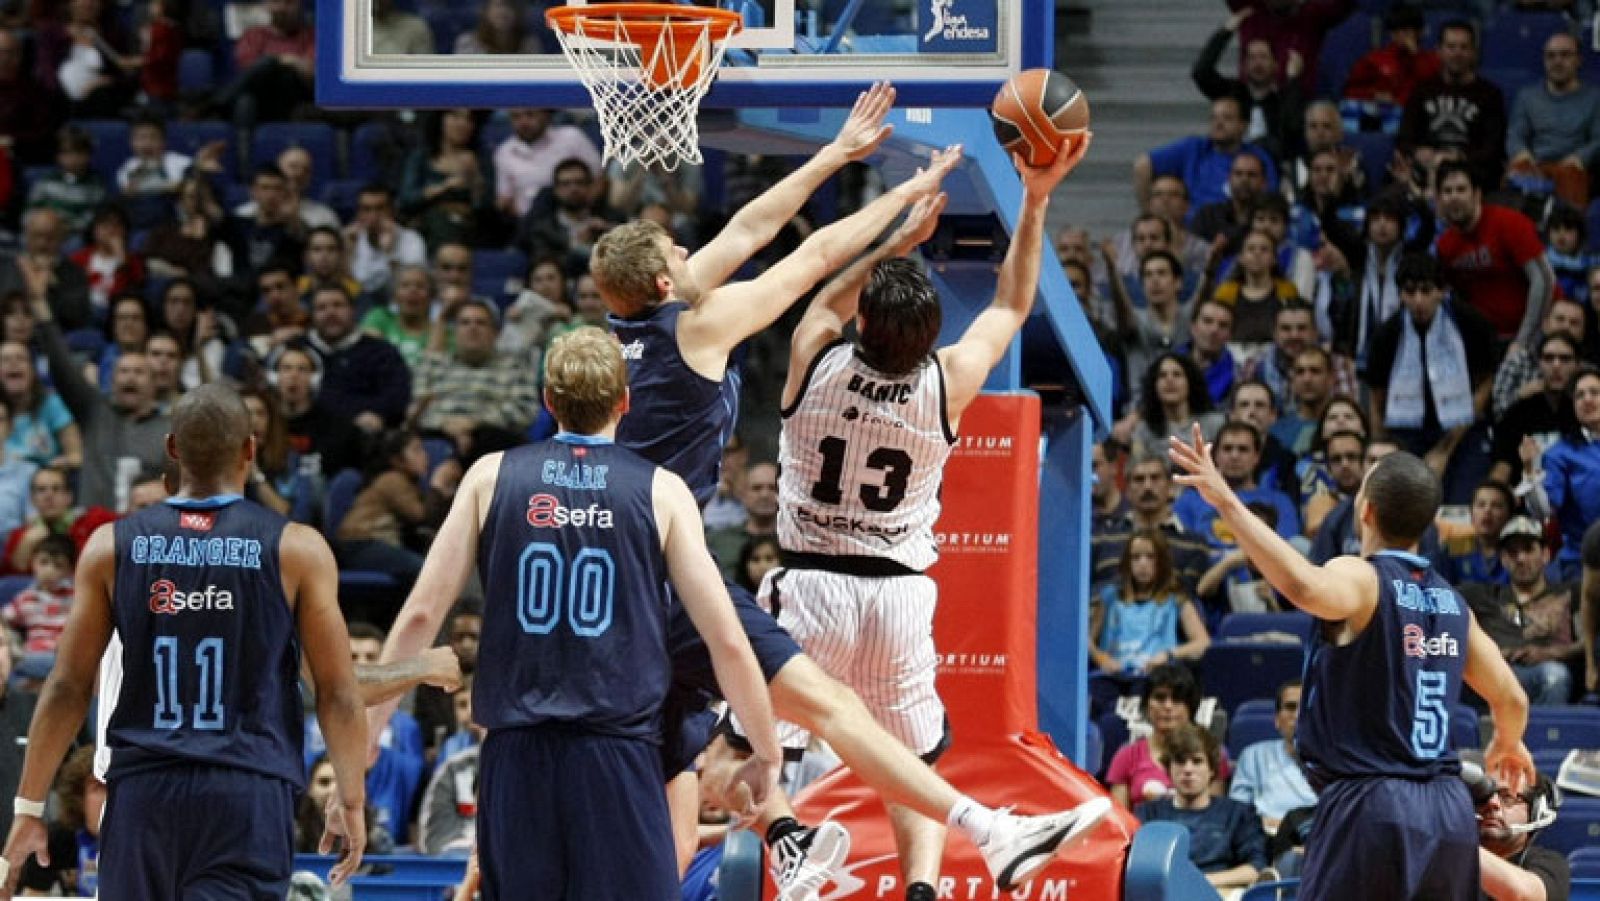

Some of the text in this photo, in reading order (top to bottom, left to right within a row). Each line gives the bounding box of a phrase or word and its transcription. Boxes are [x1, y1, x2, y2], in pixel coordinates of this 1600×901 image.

[943, 20, 989, 40] endesa
[847, 374, 912, 405] BANIC
[541, 460, 609, 489] CLARK
[811, 435, 913, 513] 13
[527, 493, 614, 529] asefa
[131, 535, 262, 570] GRANGER
[149, 579, 234, 614] asefa
[516, 541, 616, 637] 00
[1403, 623, 1459, 660] asefa
[153, 635, 224, 730] 11
[1411, 669, 1449, 760] 5
